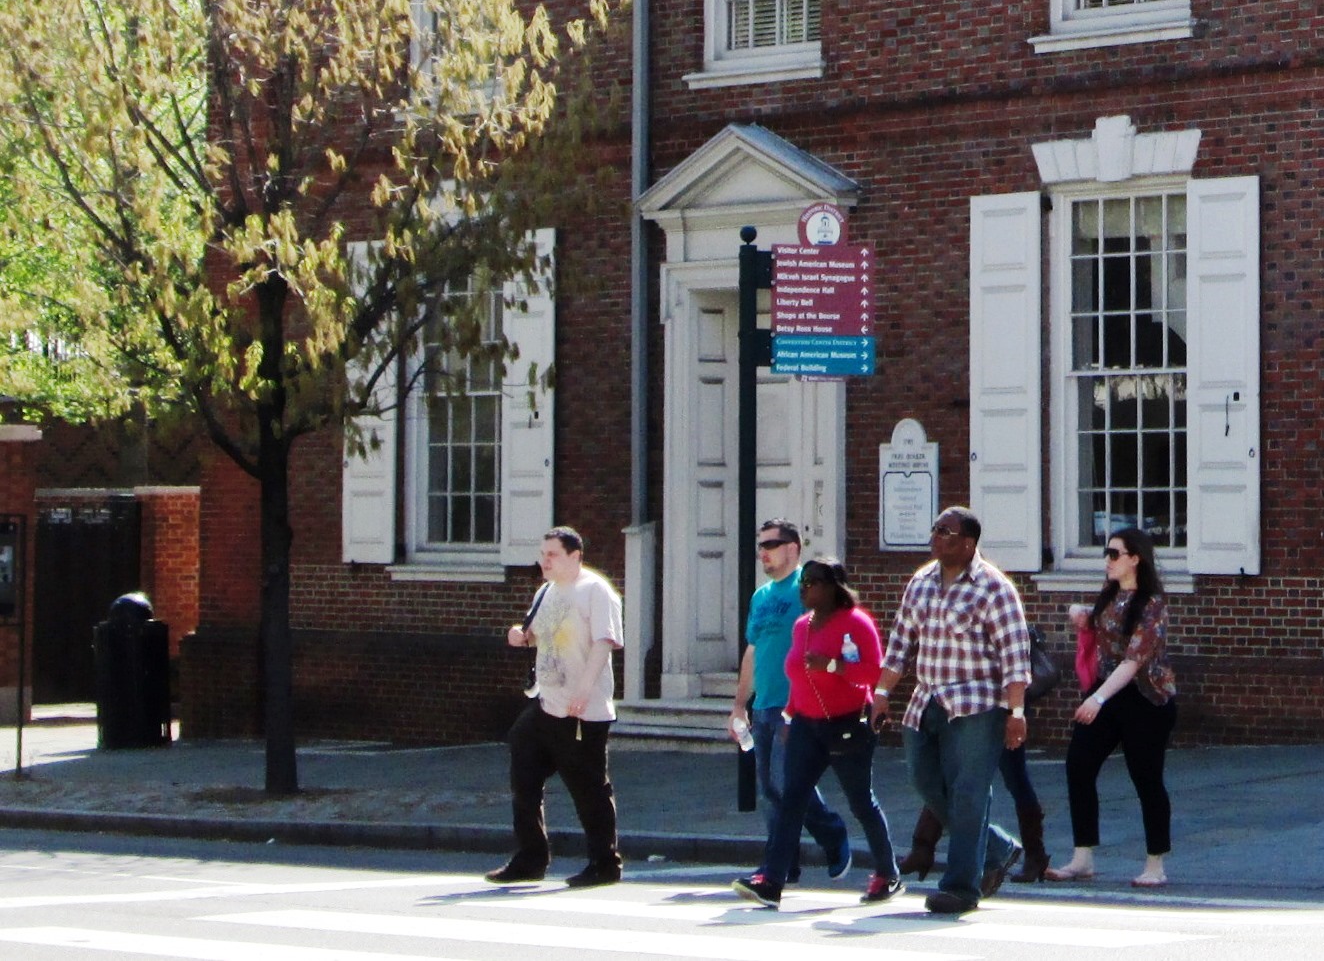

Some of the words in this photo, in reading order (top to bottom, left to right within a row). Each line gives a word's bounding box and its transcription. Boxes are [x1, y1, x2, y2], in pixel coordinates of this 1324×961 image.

[798, 260, 827, 268] American
[820, 274, 855, 283] Synagogue
[776, 286, 820, 294] Independence
[776, 298, 799, 307] Liberty
[776, 325, 795, 333] Betsy
